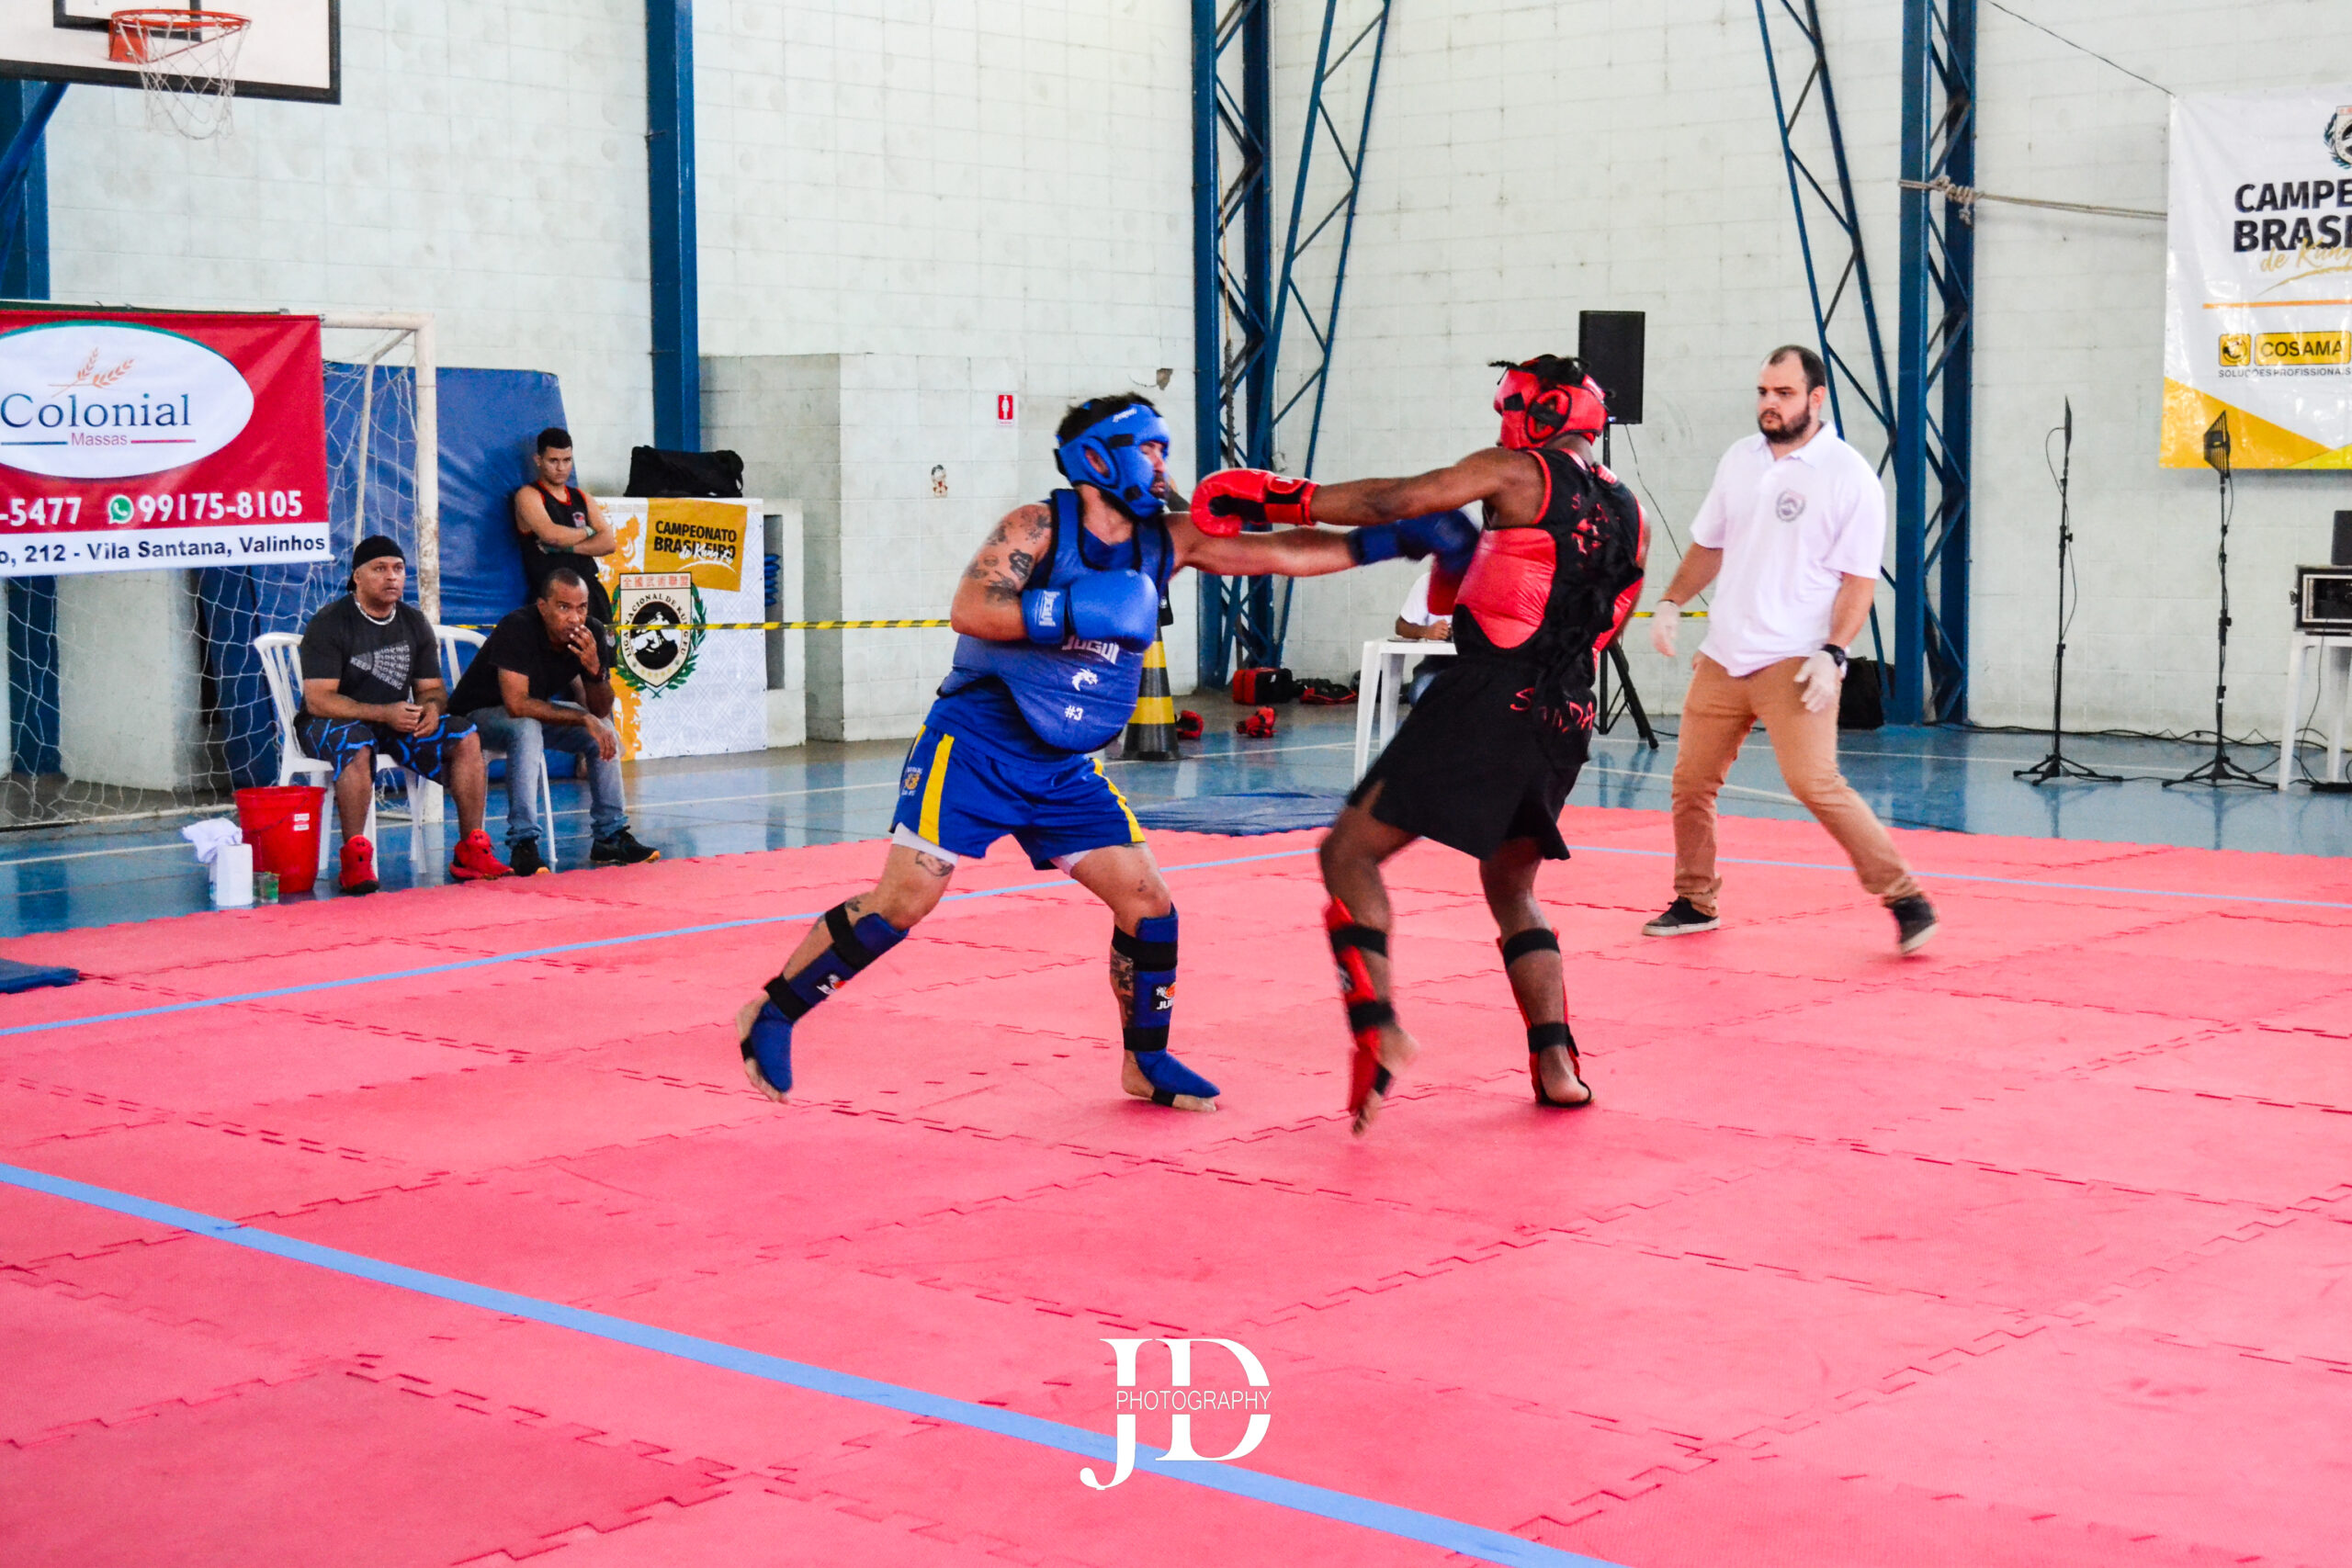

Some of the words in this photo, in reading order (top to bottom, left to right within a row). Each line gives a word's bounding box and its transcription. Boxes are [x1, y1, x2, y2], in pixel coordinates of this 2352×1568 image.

[2234, 178, 2352, 213] CAMPE
[2260, 246, 2287, 272] de
[2261, 341, 2343, 356] COSAMA
[2274, 367, 2351, 376] PROFISSIONAS
[1, 393, 192, 428] Colonial
[71, 433, 128, 446] Massas
[138, 491, 303, 522] 99175-8105
[655, 520, 737, 543] CAMPEONATO
[24, 545, 66, 562] 212
[87, 542, 130, 559] Vila
[138, 540, 232, 558] Santana,
[239, 535, 325, 553] Valinhos
[665, 595, 678, 606] DE
[1065, 705, 1084, 721] #3
